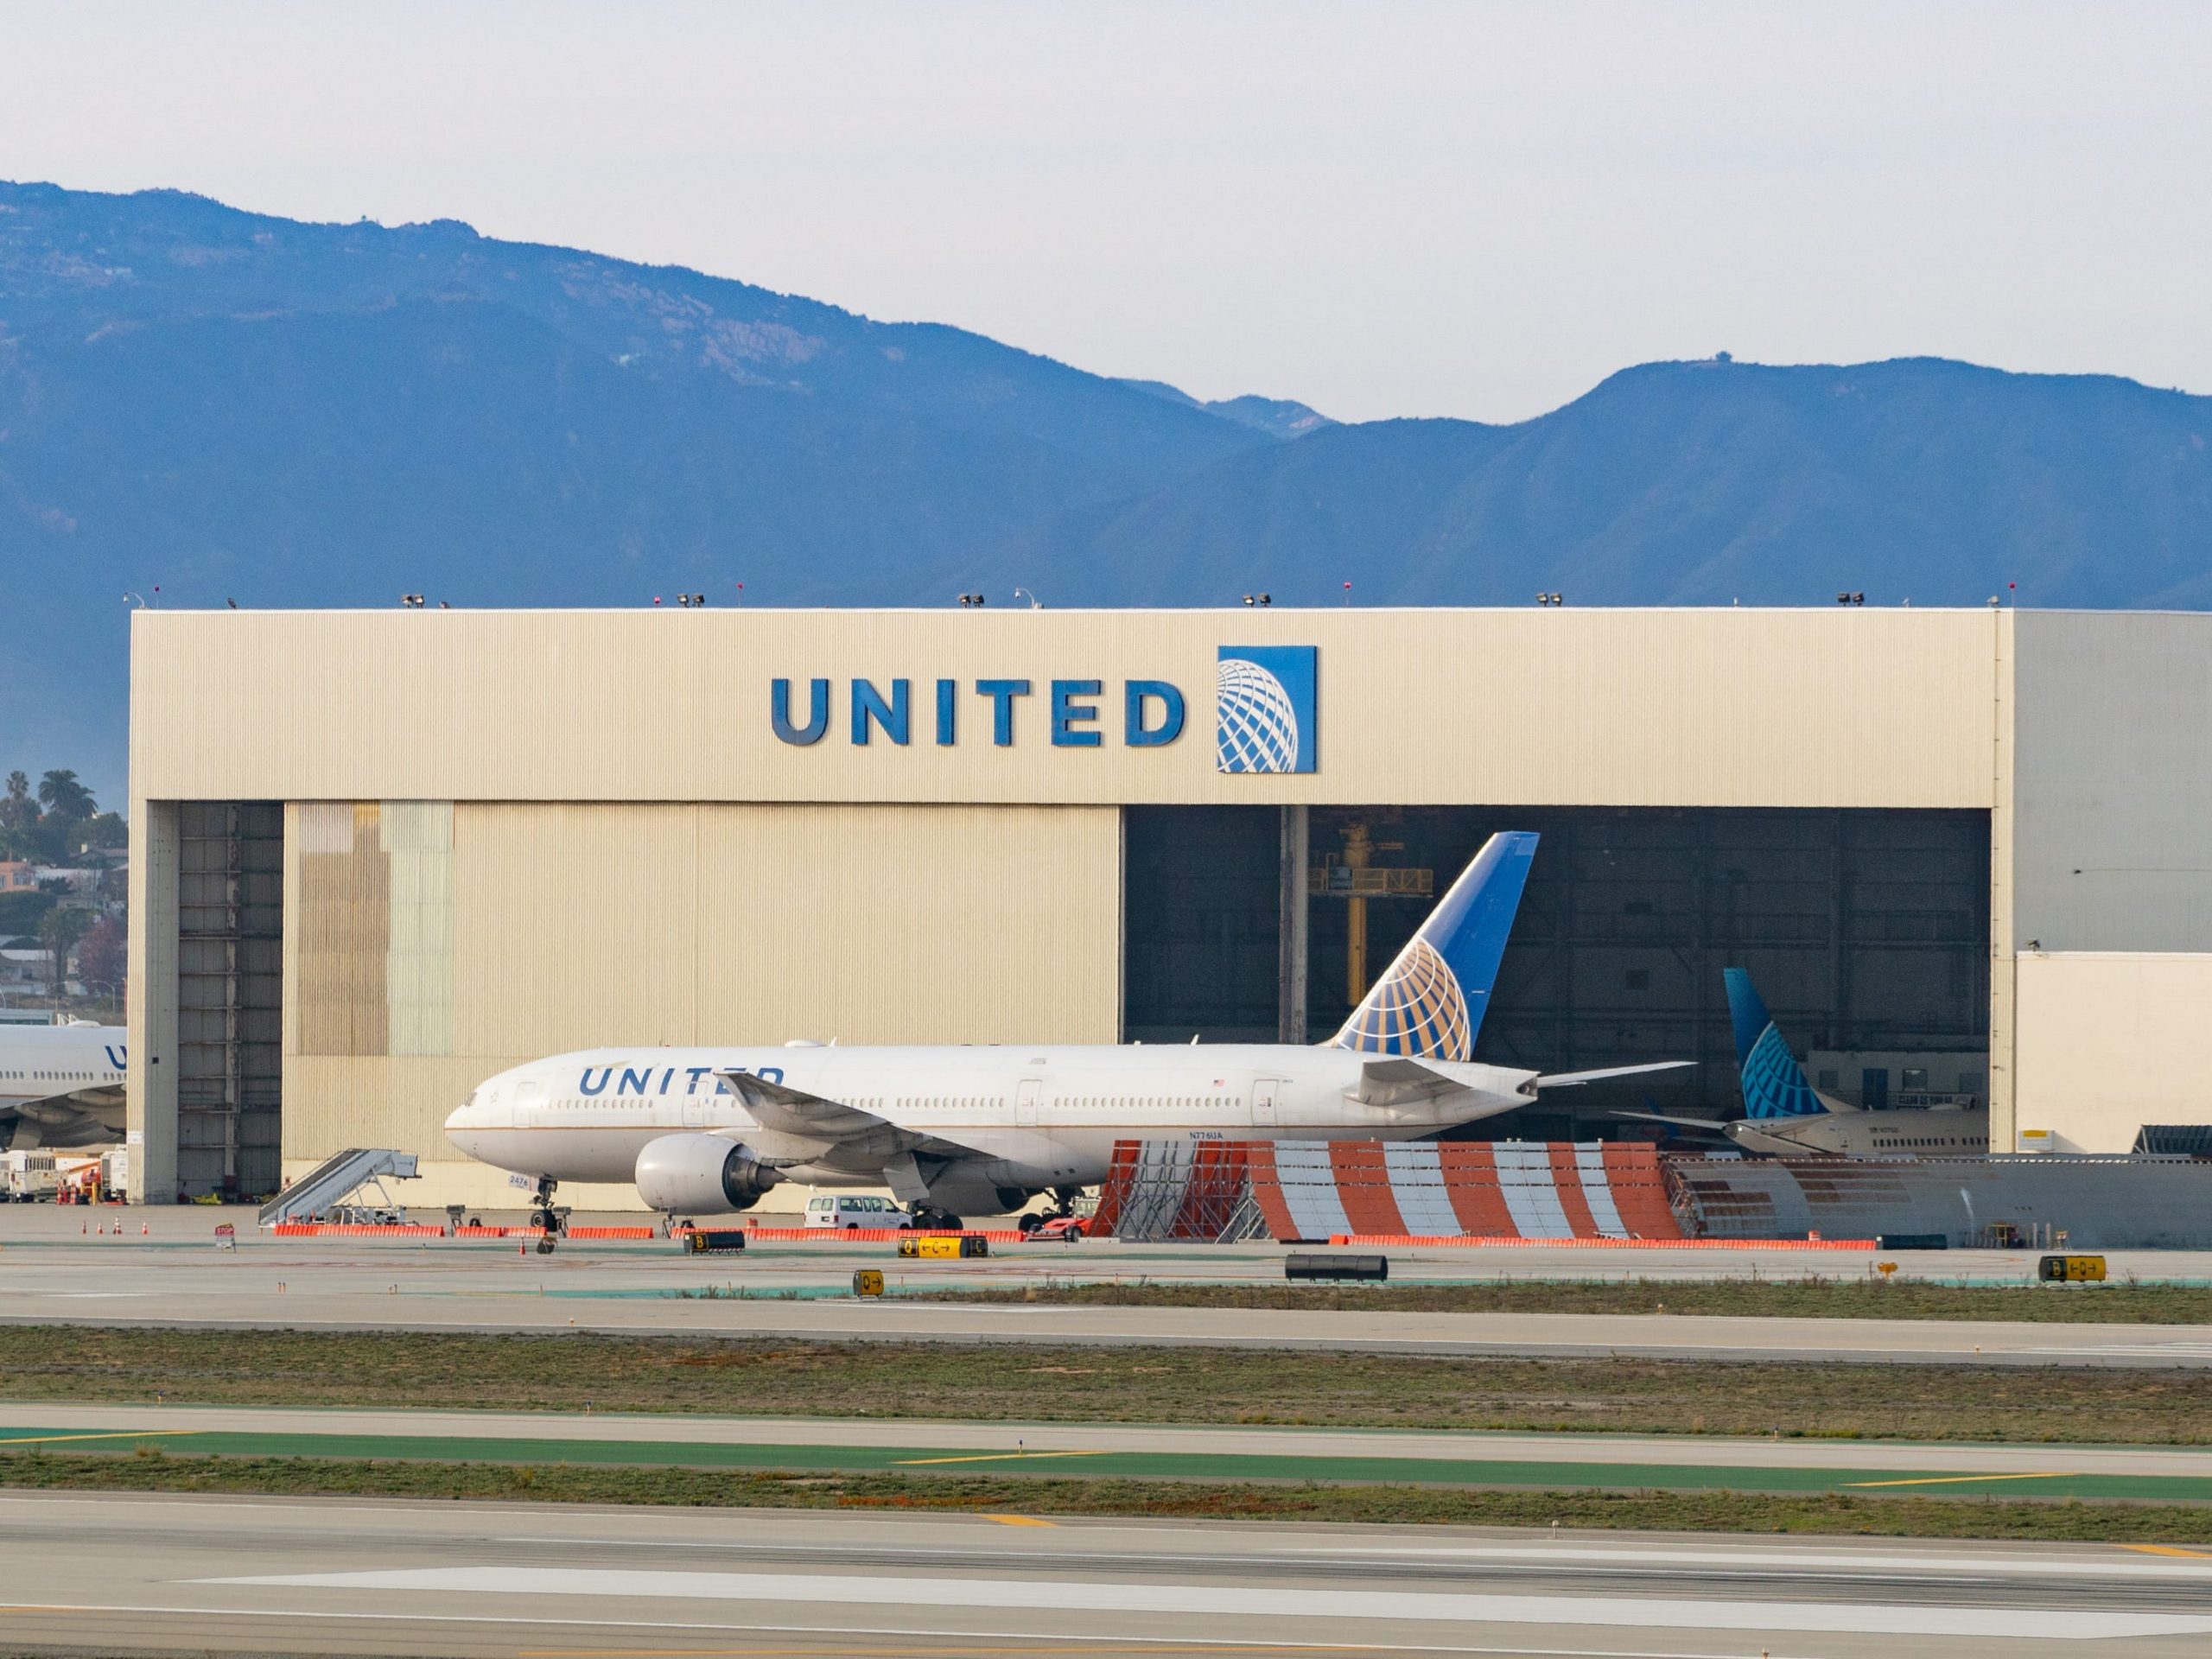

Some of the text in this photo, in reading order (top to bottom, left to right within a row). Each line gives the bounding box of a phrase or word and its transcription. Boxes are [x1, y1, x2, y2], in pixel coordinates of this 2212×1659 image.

[771, 678, 1186, 747] UNITED
[696, 1235, 704, 1249] B
[932, 1242, 939, 1254] C
[976, 1240, 982, 1253] C
[2052, 1261, 2061, 1276] B
